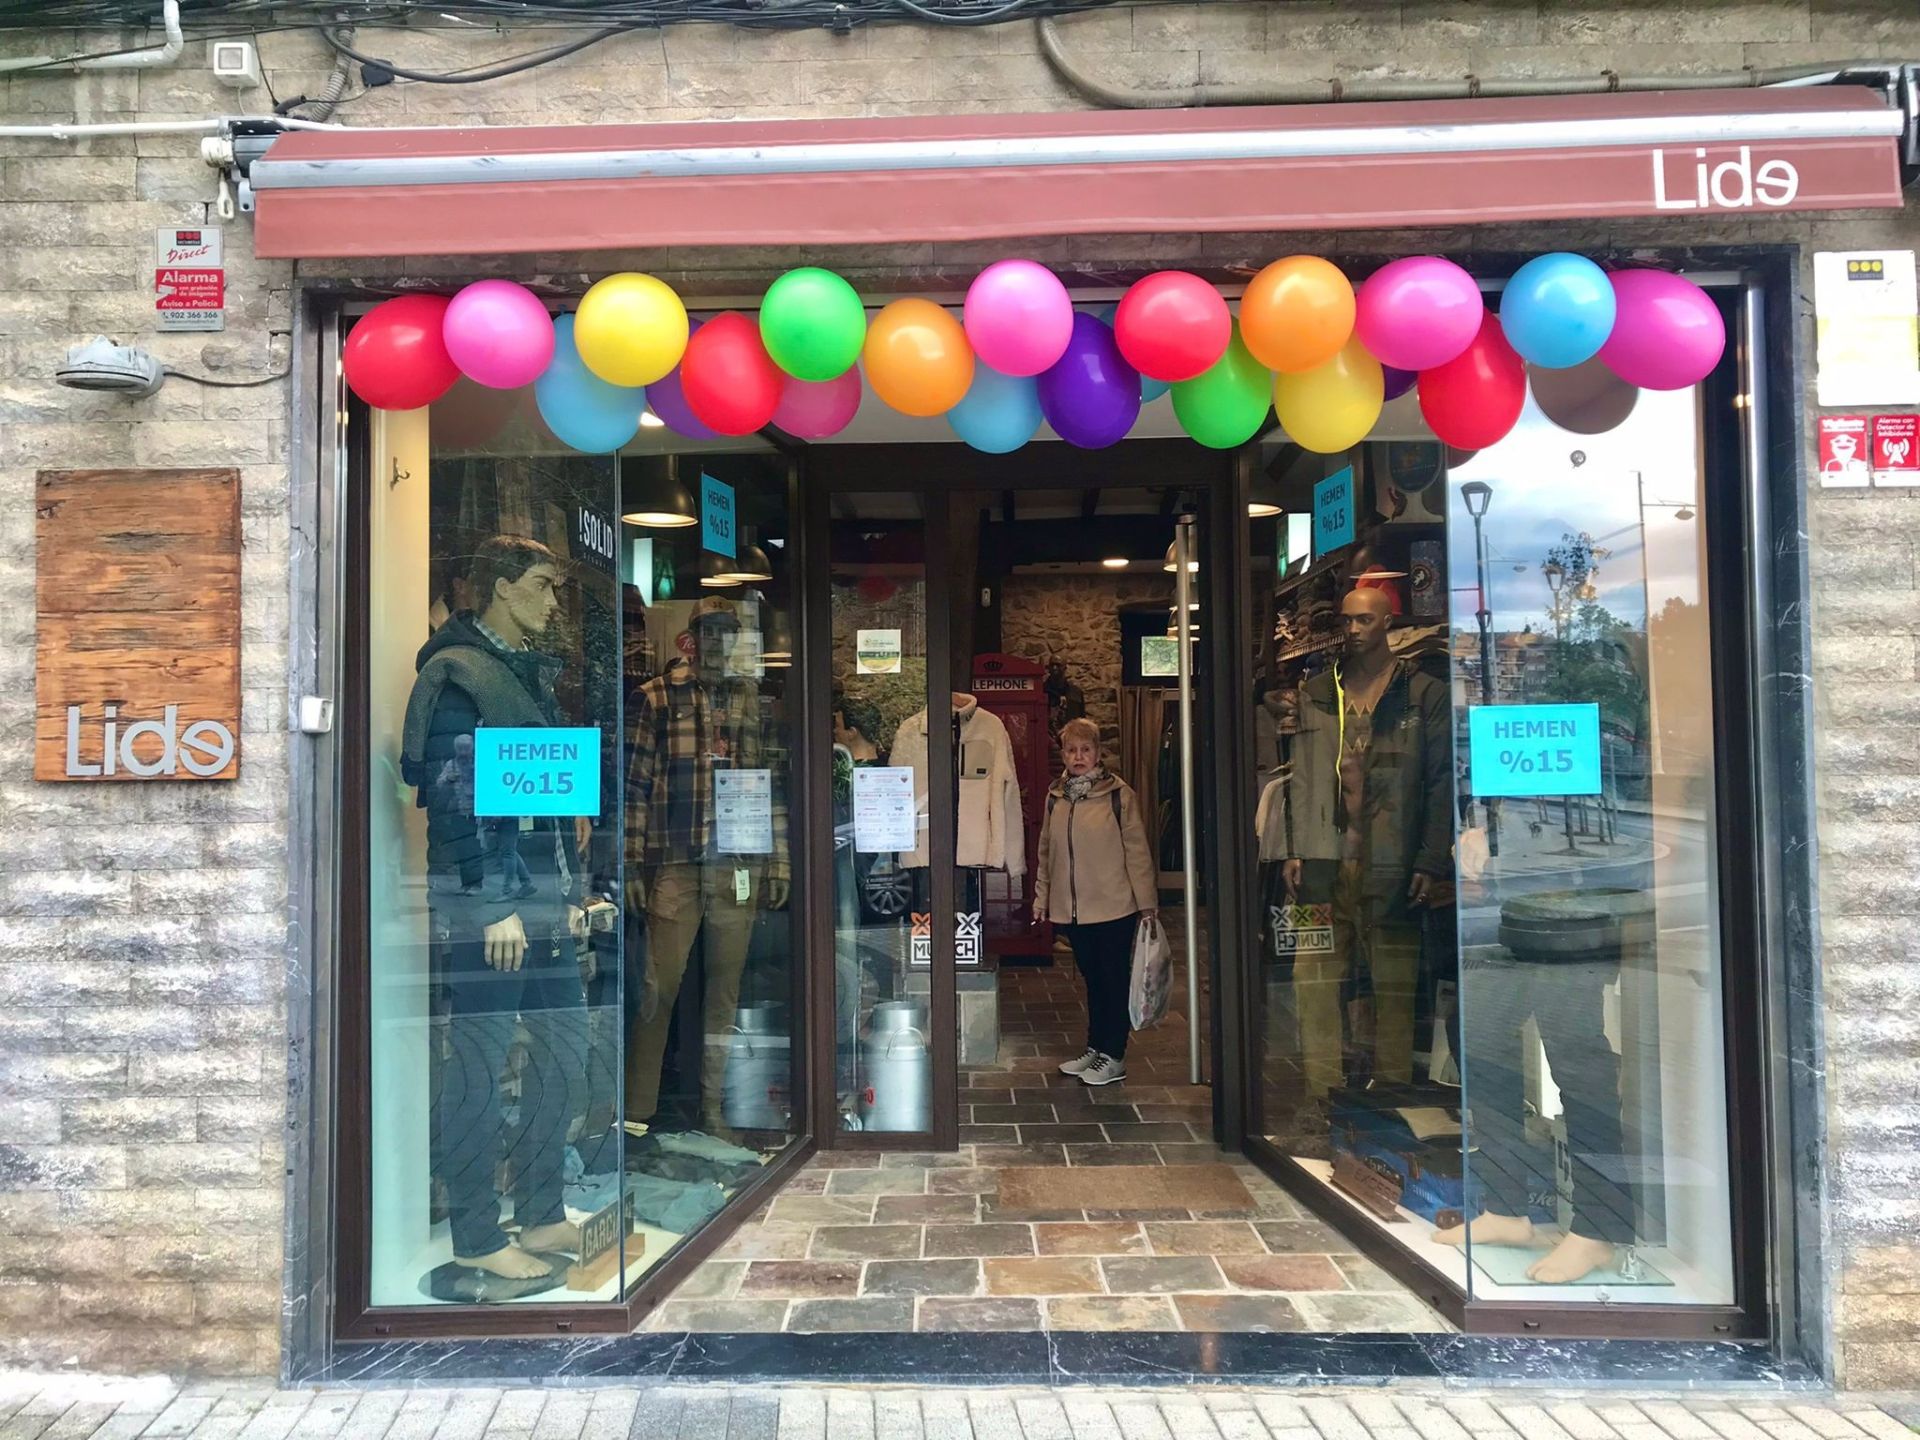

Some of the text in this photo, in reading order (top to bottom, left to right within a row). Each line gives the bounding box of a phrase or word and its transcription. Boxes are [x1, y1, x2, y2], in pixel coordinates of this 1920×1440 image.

[1653, 145, 1799, 209] Lide
[166, 244, 213, 264] Direct
[161, 270, 218, 283] Alarma
[170, 311, 218, 319] 902 366 366
[707, 490, 731, 512] HEMEN
[1320, 484, 1346, 507] HEMEN
[709, 514, 730, 539] %15
[1322, 511, 1345, 534] %15
[66, 704, 234, 776] Lide
[1494, 720, 1577, 739] HEMEN
[498, 744, 578, 761] HEMEN
[1500, 750, 1574, 773] %15
[503, 772, 574, 795] %15
